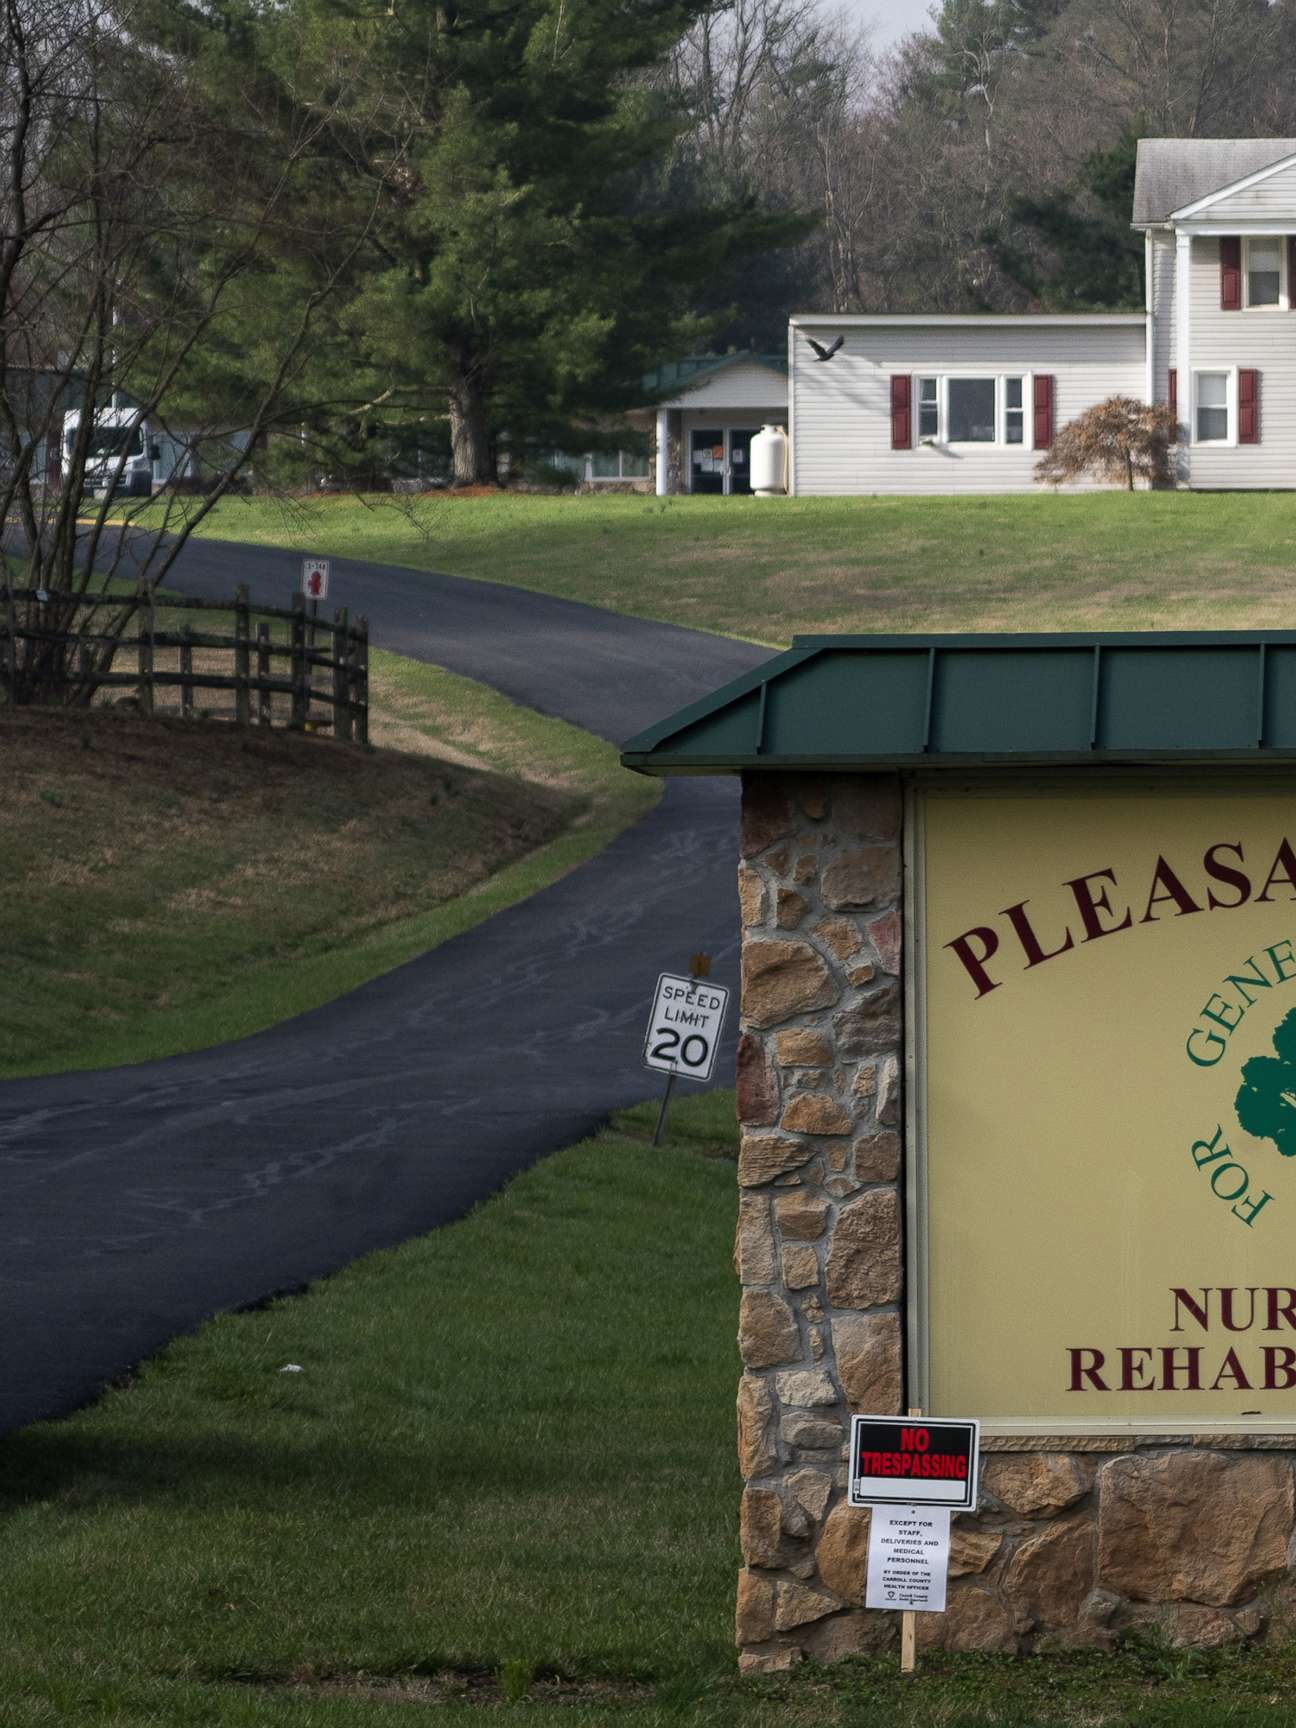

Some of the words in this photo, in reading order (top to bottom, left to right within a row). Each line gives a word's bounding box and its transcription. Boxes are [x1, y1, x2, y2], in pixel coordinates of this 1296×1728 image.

[662, 985, 721, 1010] SPEED
[663, 1006, 710, 1029] LIMIT
[650, 1026, 709, 1068] 20
[1190, 1123, 1276, 1229] FOR
[899, 1427, 930, 1452] NO
[861, 1451, 968, 1479] TRESPASSING
[889, 1519, 917, 1527] EXCEPT
[918, 1520, 934, 1528] FOR
[880, 1538, 922, 1546] DELIVERIES
[923, 1539, 939, 1547] AND
[893, 1548, 925, 1556] MEDICAL
[886, 1557, 929, 1565] PERSONNEL
